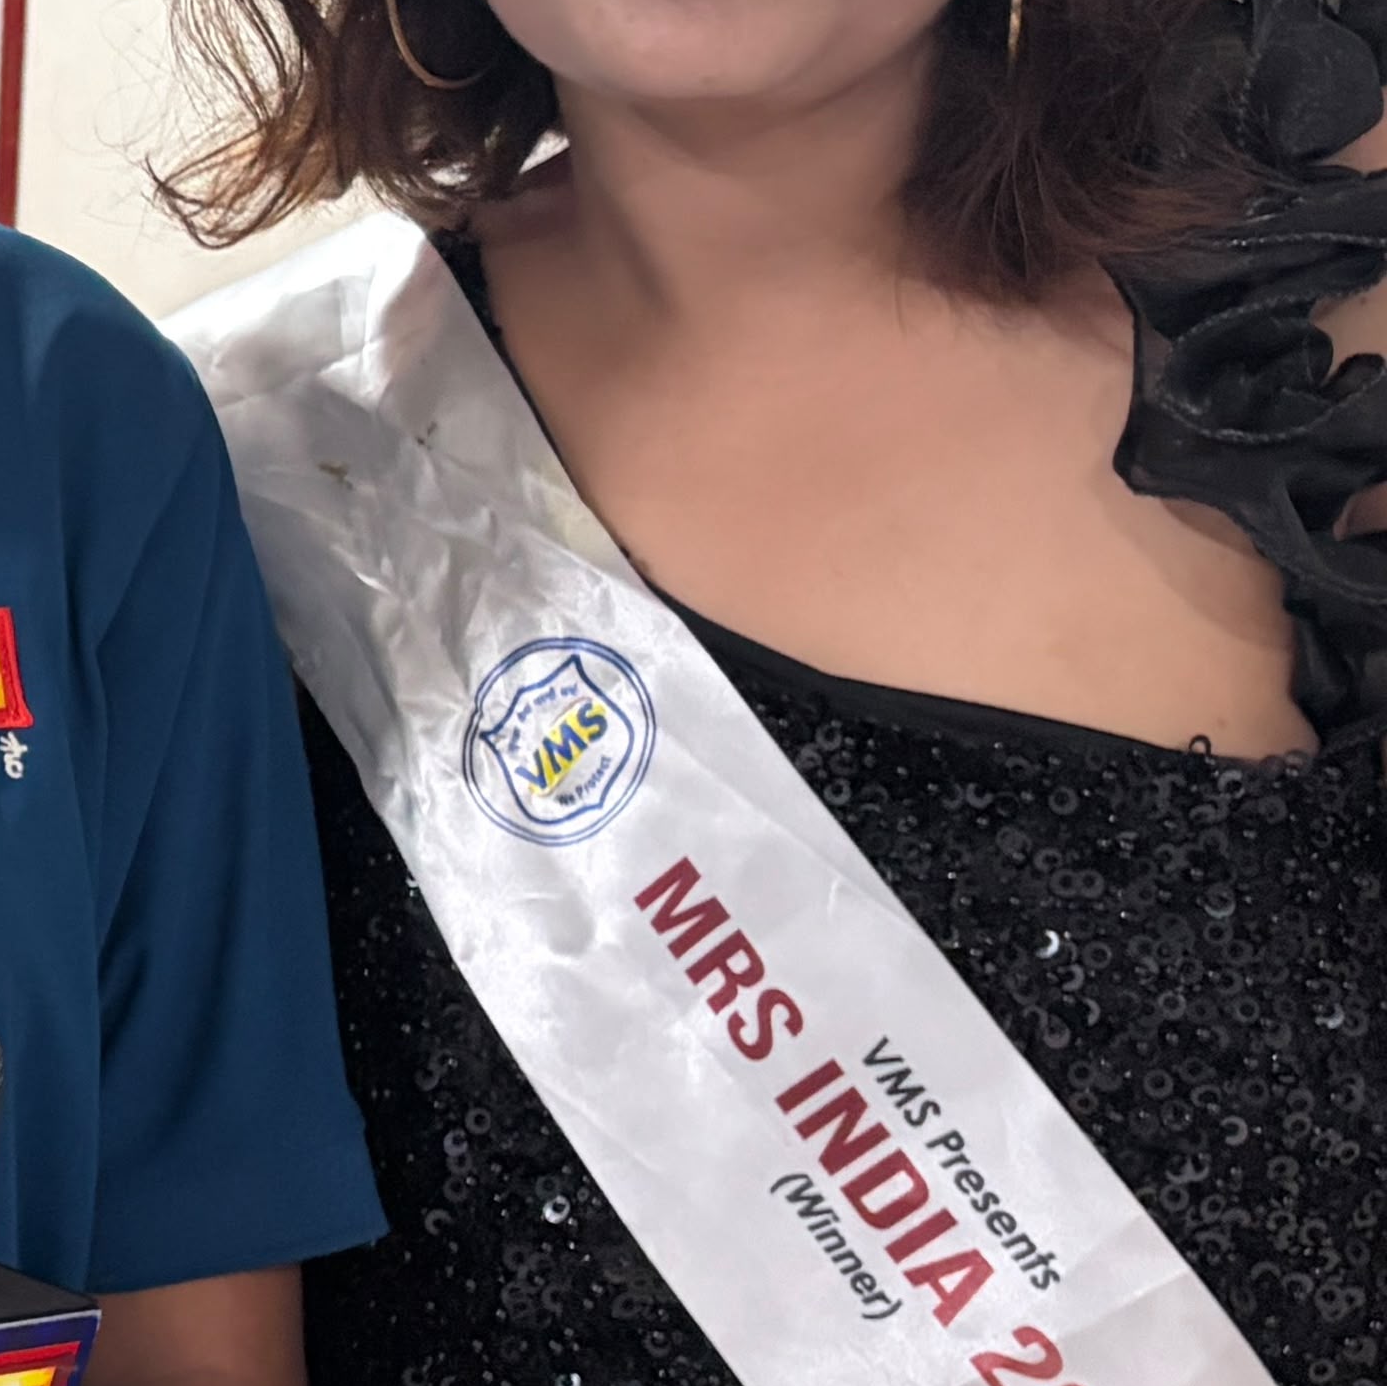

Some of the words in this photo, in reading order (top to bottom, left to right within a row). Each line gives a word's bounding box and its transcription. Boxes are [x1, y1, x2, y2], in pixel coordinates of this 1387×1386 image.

[0, 731, 28, 780] है
[514, 701, 609, 789] VMS
[575, 756, 613, 799] Protect
[634, 856, 804, 1062] MRS
[775, 1058, 995, 1327] INDIA
[861, 1037, 942, 1128] VMS
[926, 1129, 1061, 1291] Presents
[769, 1172, 903, 1321] (Winner)
